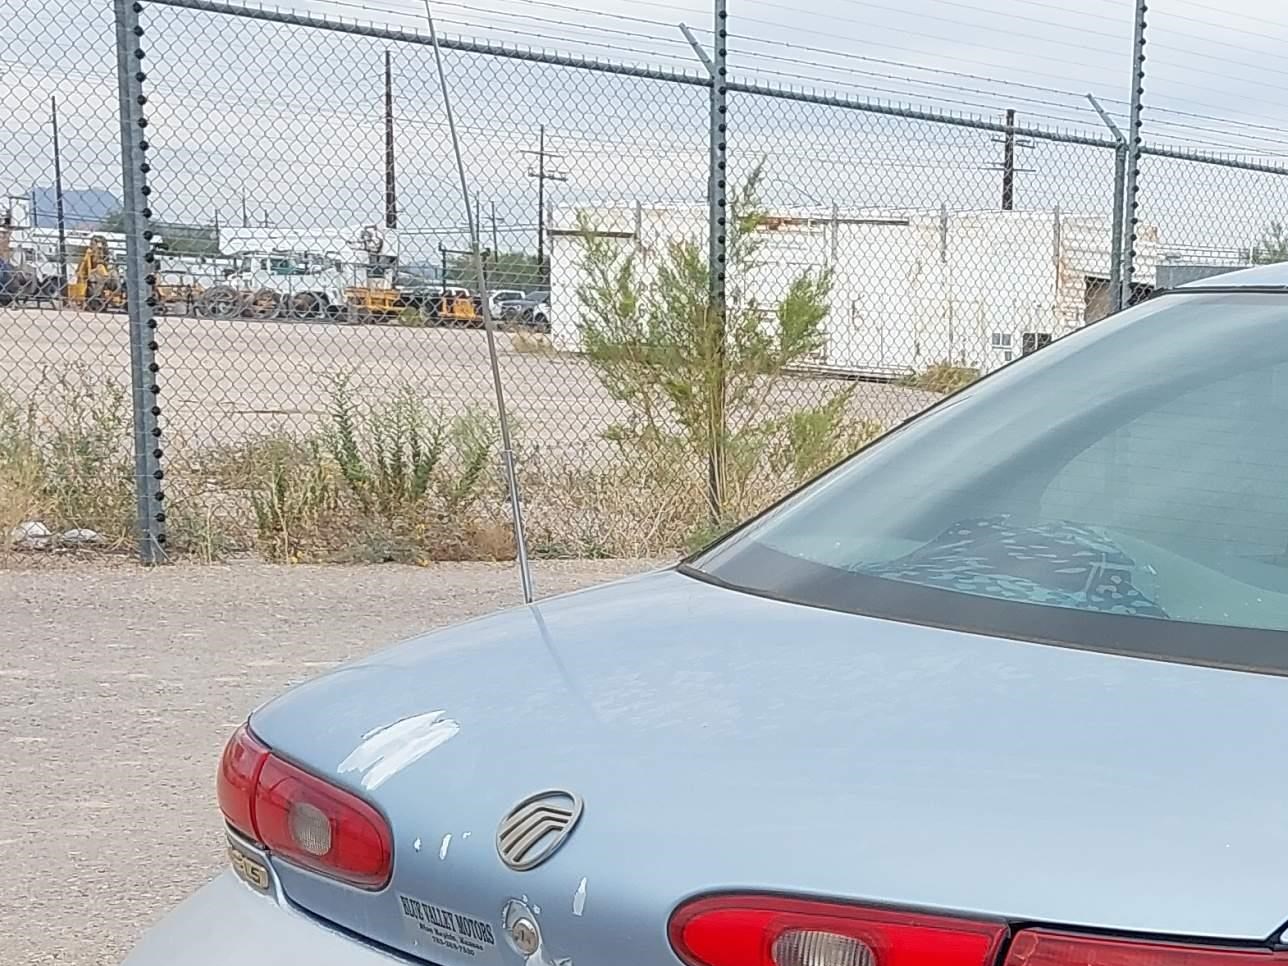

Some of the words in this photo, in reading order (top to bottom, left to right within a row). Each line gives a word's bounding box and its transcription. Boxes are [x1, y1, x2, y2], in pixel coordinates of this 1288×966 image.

[400, 895, 424, 921] BLUE
[422, 902, 457, 933] VALLEY
[454, 914, 495, 945] MOTORS
